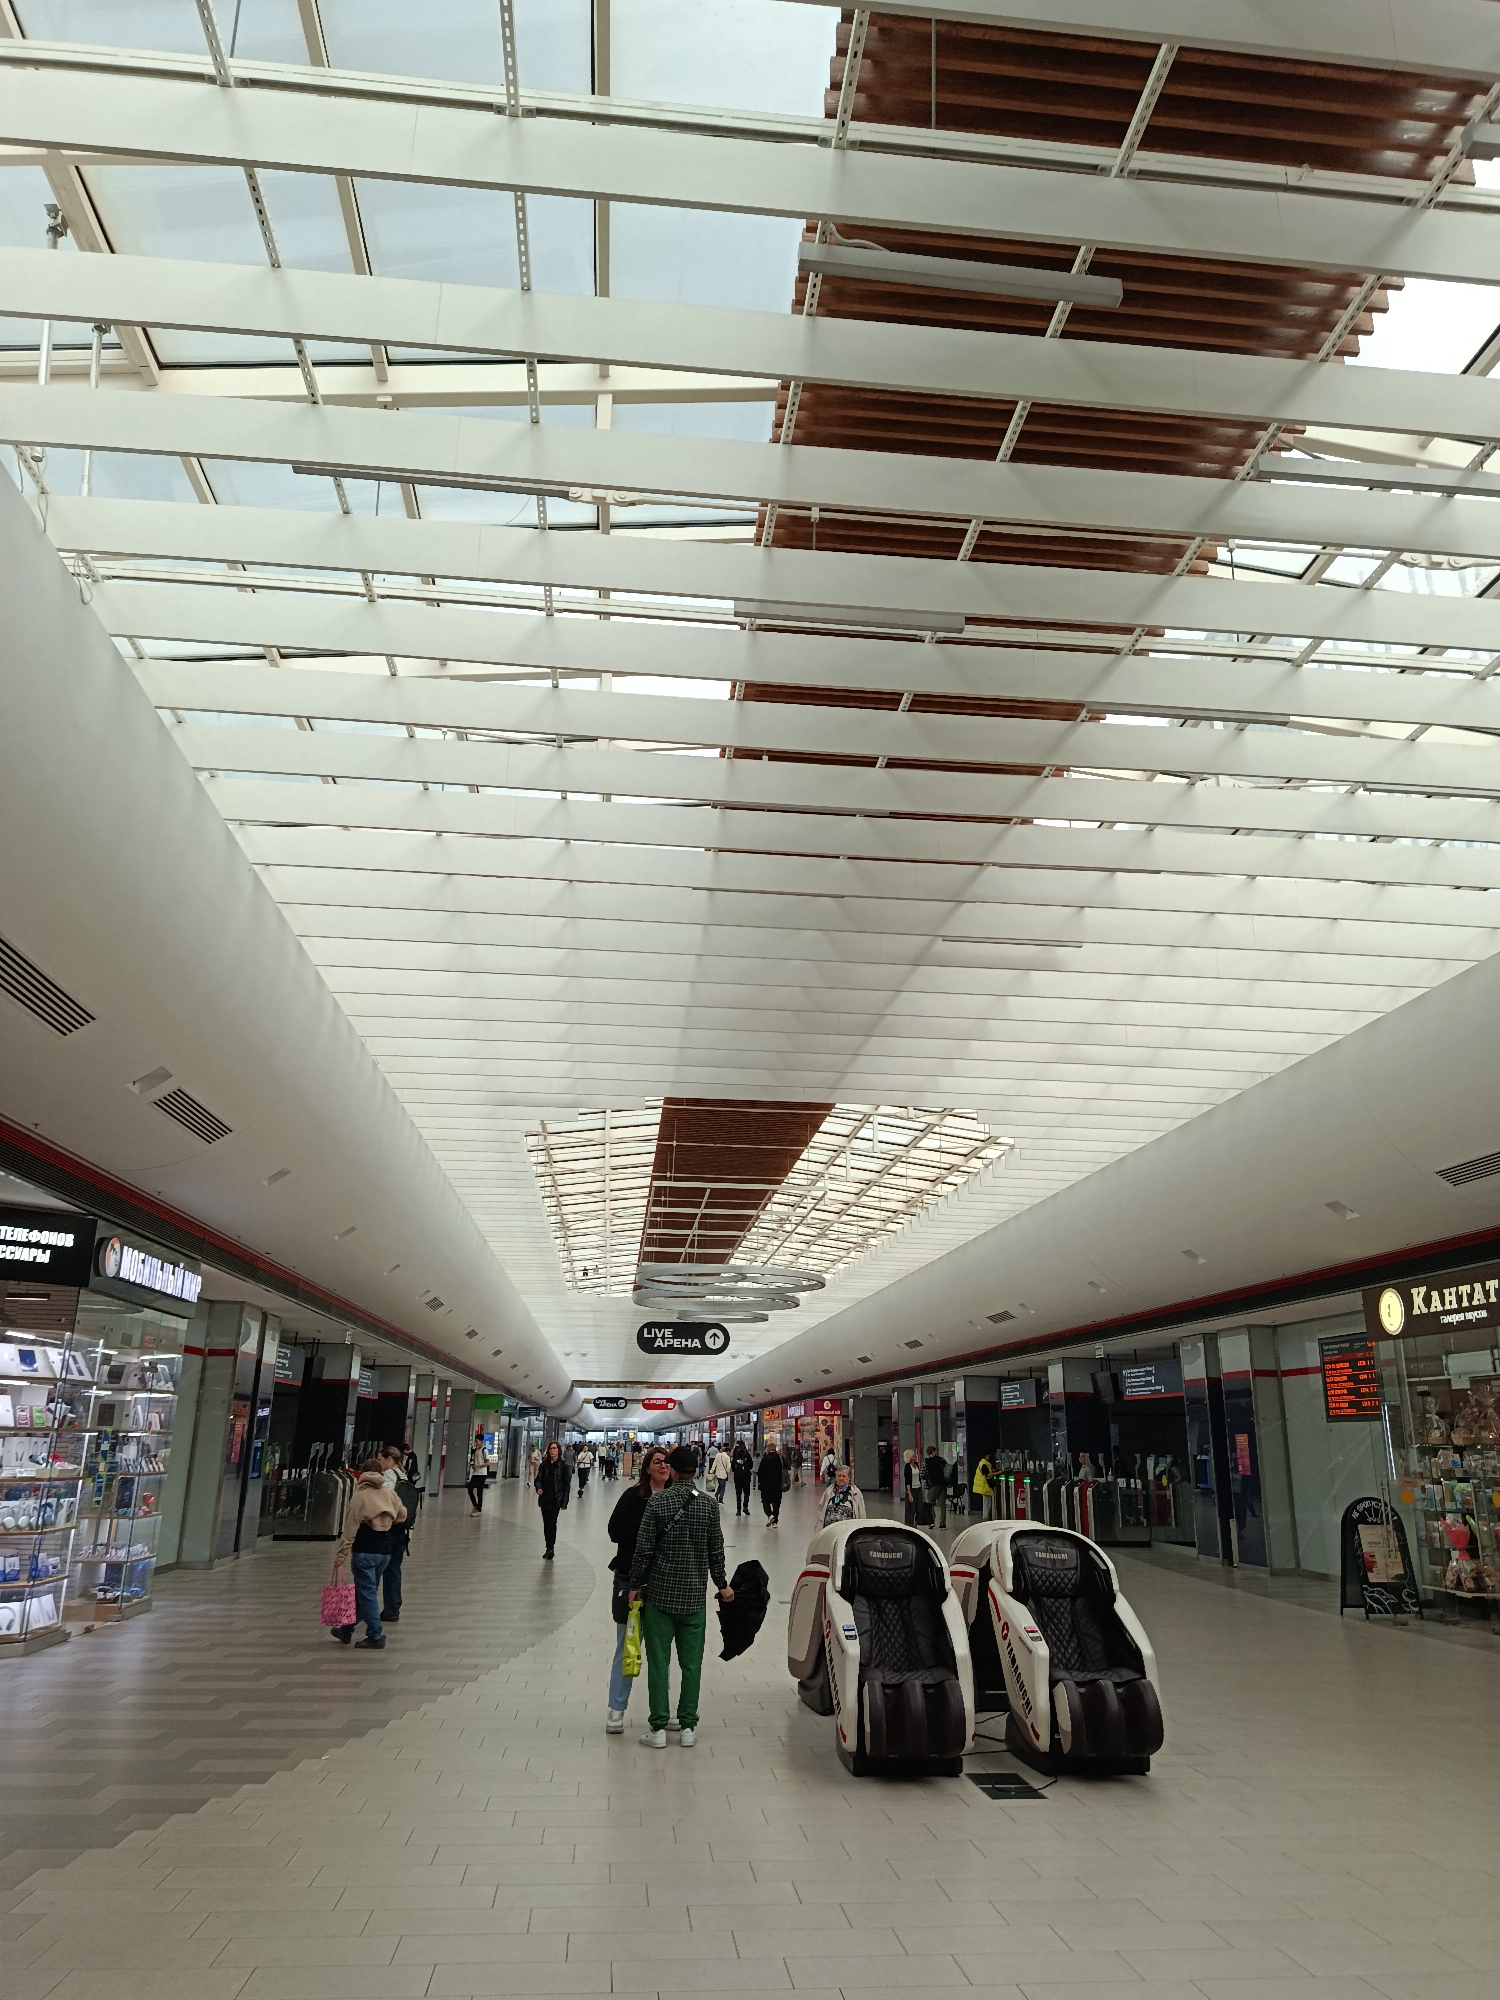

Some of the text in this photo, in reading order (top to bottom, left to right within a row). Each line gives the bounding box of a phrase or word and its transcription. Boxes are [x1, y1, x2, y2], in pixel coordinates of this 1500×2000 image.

[0, 1226, 75, 1247] ТЕЛЕФОНОВ
[119, 1245, 202, 1303] МОБИЛЬНЫЙ МИР
[1440, 1309, 1488, 1326] галерея вкусов
[643, 1327, 674, 1338] LIVE
[653, 1338, 702, 1348] АРЕНА
[869, 1550, 903, 1559] YAMAGUCHI
[1034, 1551, 1068, 1560] YAMAGUCHI
[1005, 1638, 1033, 1717] YAMAGUCHI
